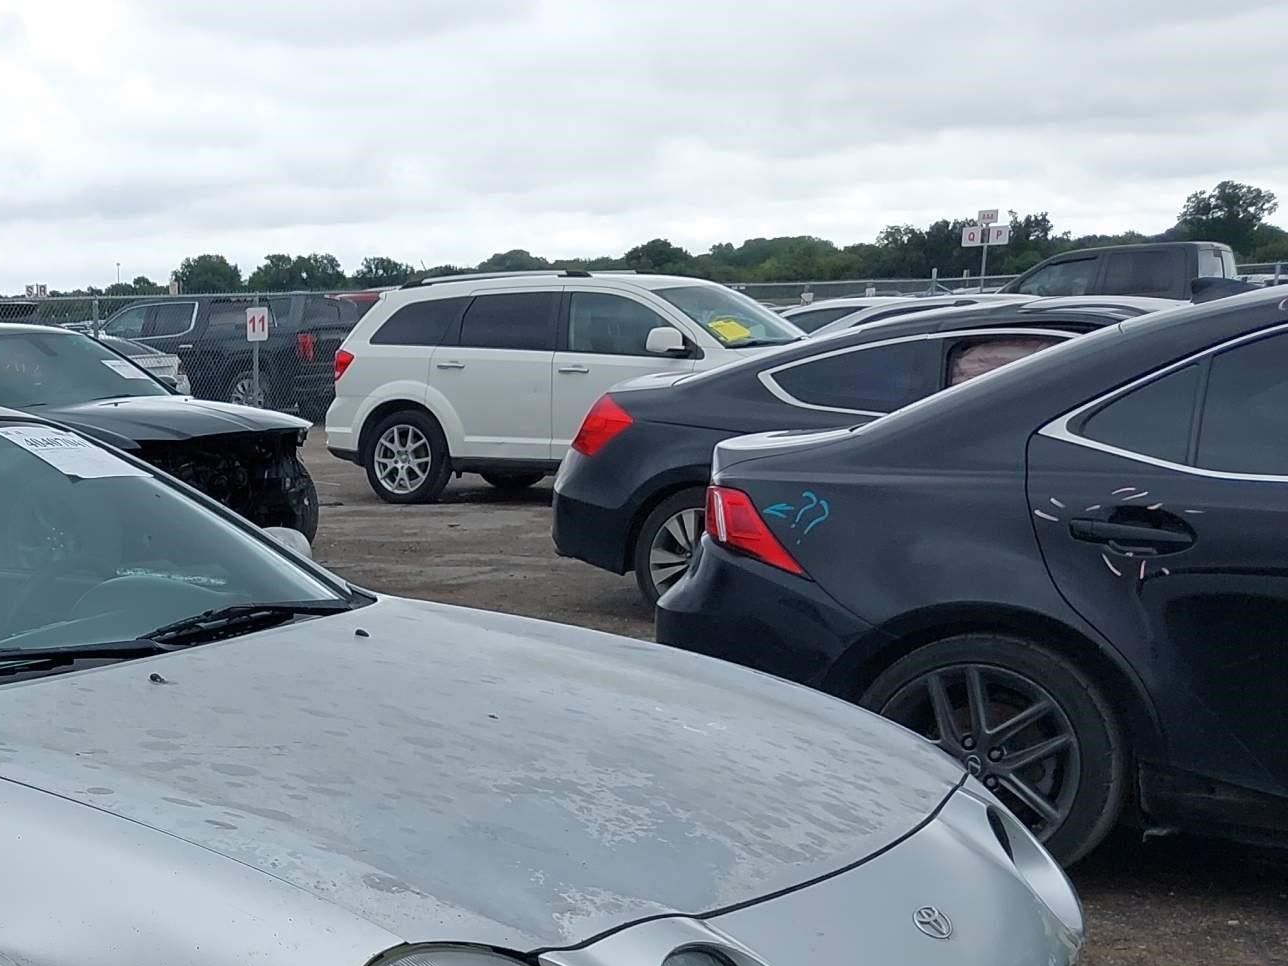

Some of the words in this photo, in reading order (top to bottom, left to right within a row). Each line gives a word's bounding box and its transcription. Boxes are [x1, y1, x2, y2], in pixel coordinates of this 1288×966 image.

[968, 232, 975, 241] Q
[996, 230, 1002, 240] P
[26, 286, 33, 297] S
[249, 315, 265, 333] 11
